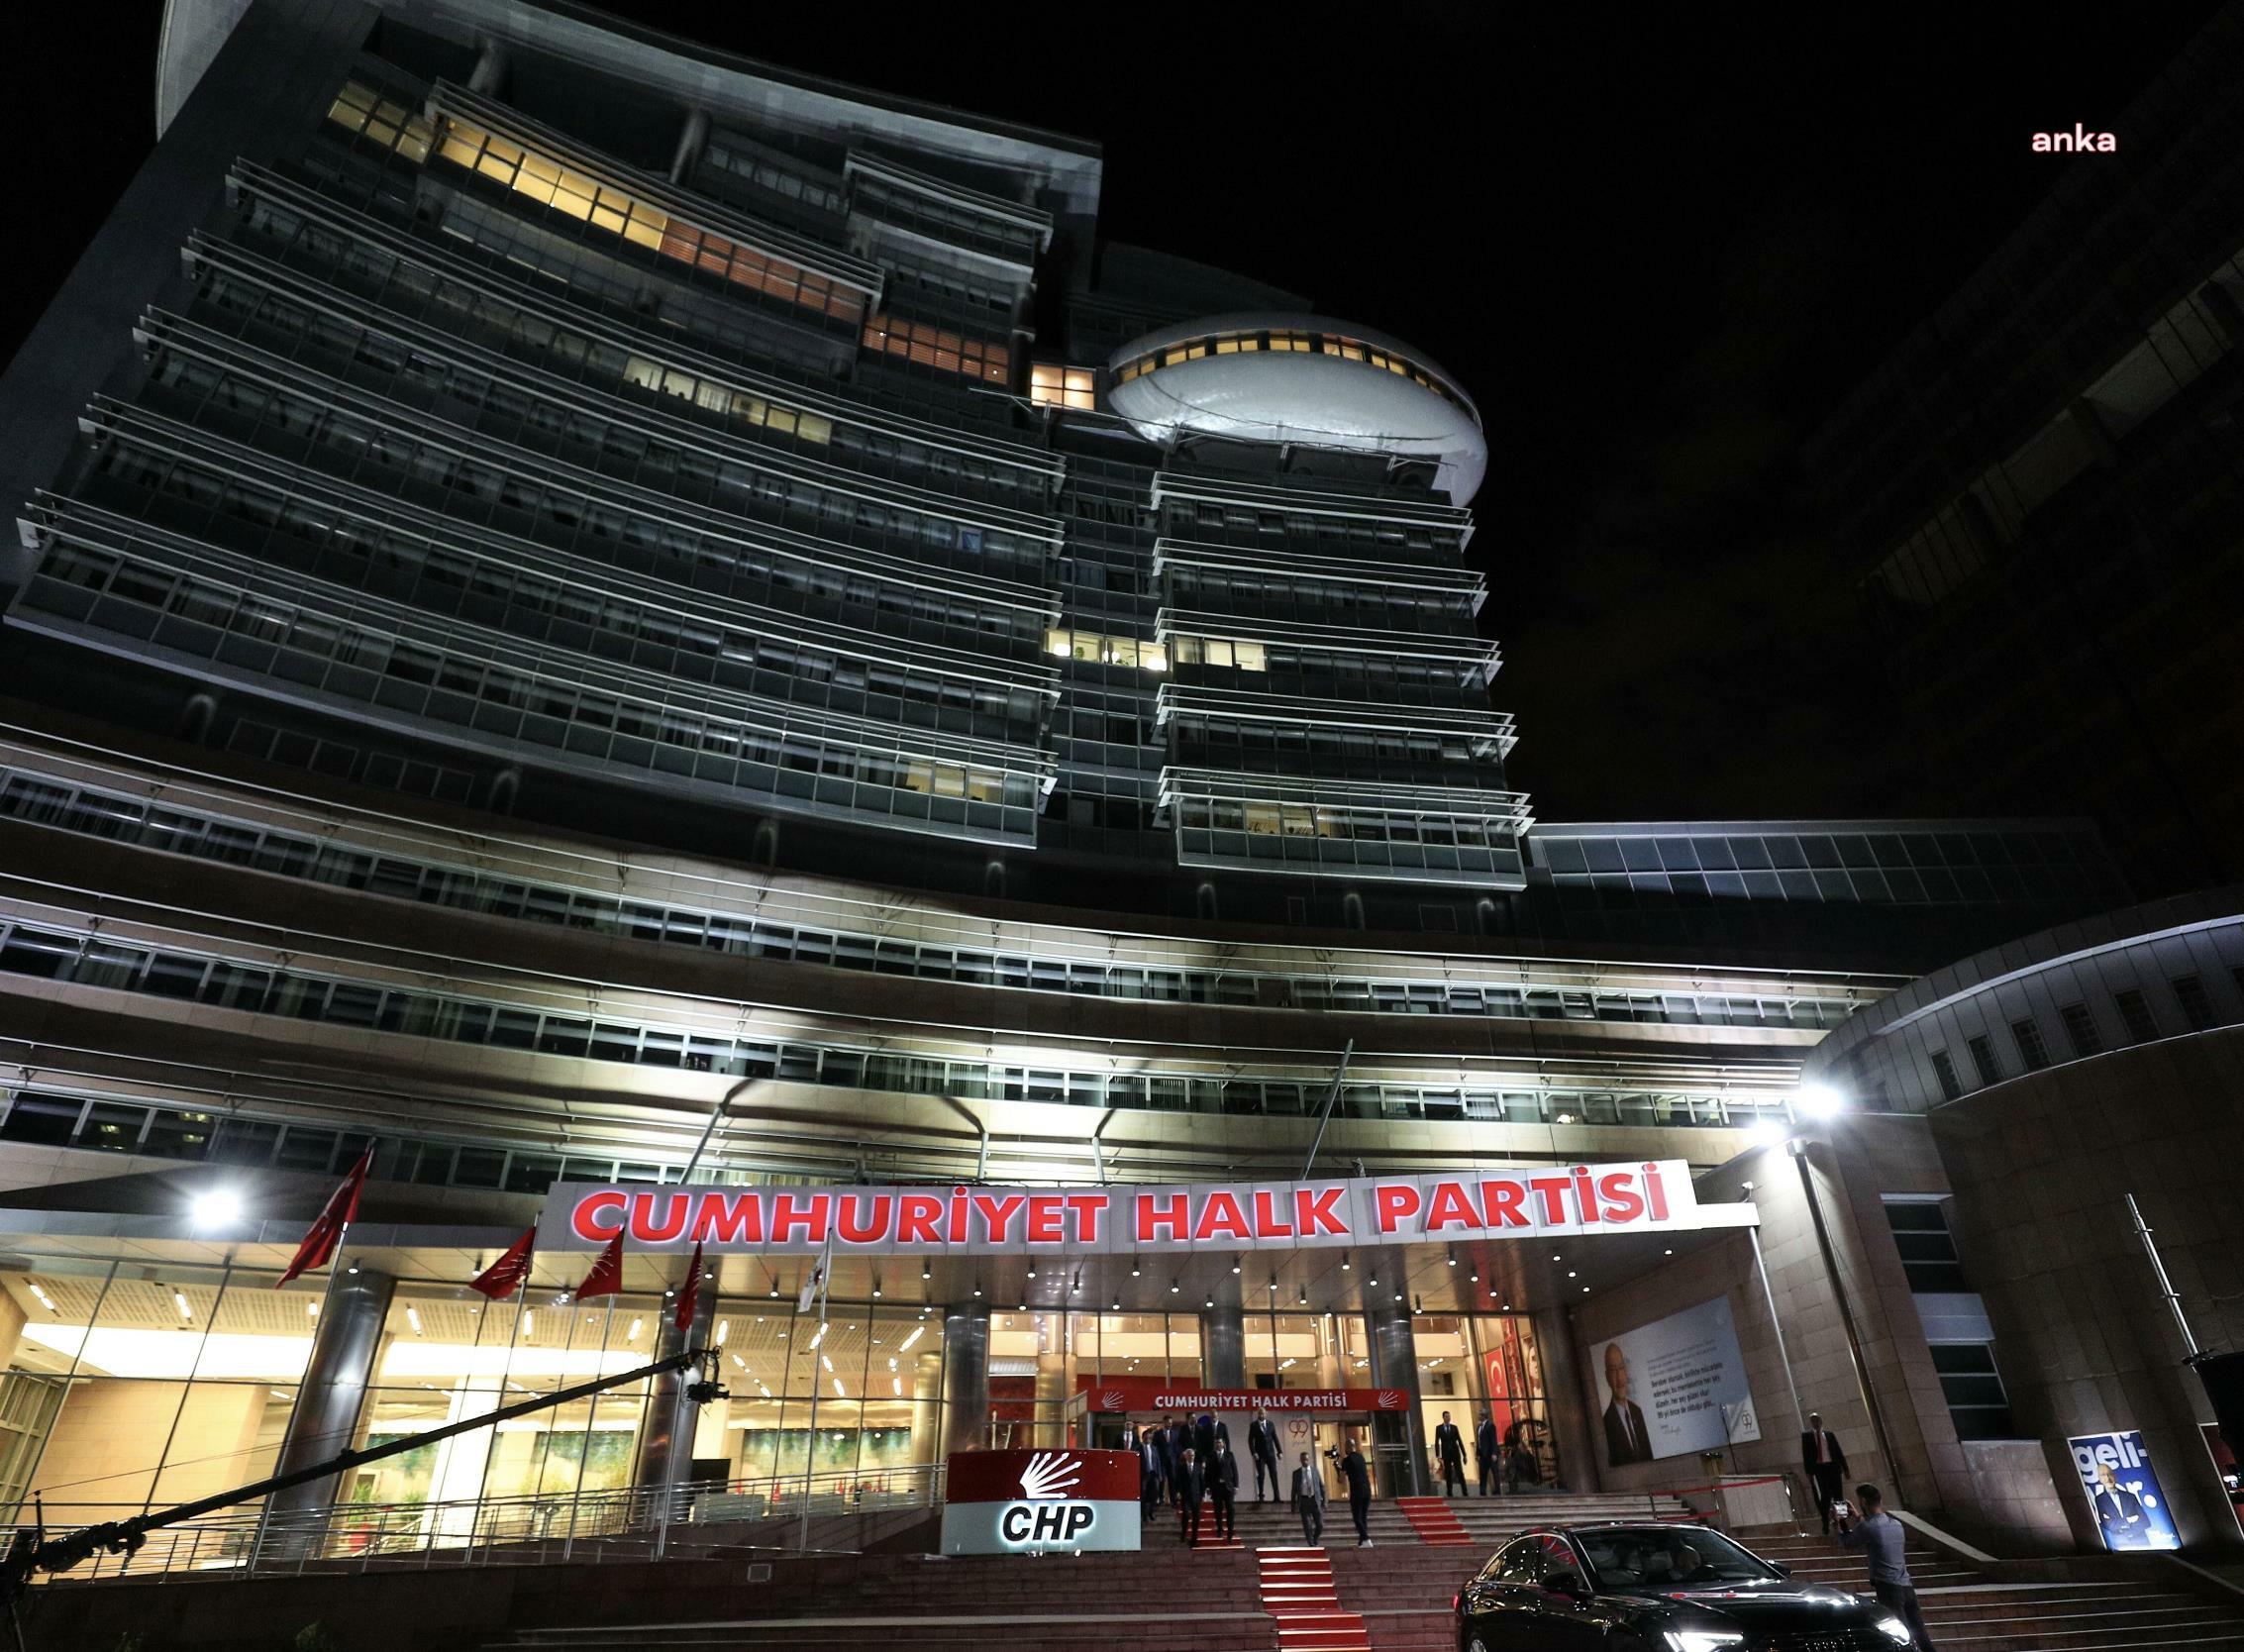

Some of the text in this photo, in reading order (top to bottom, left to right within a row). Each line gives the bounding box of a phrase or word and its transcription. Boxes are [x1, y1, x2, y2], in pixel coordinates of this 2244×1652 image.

[571, 1162, 1671, 1243] CUMHURİYET HALK PARTİSİ
[1155, 1393, 1348, 1408] CUMHURİYET HALK PARTİSİ
[1002, 1505, 1094, 1542] CHP
